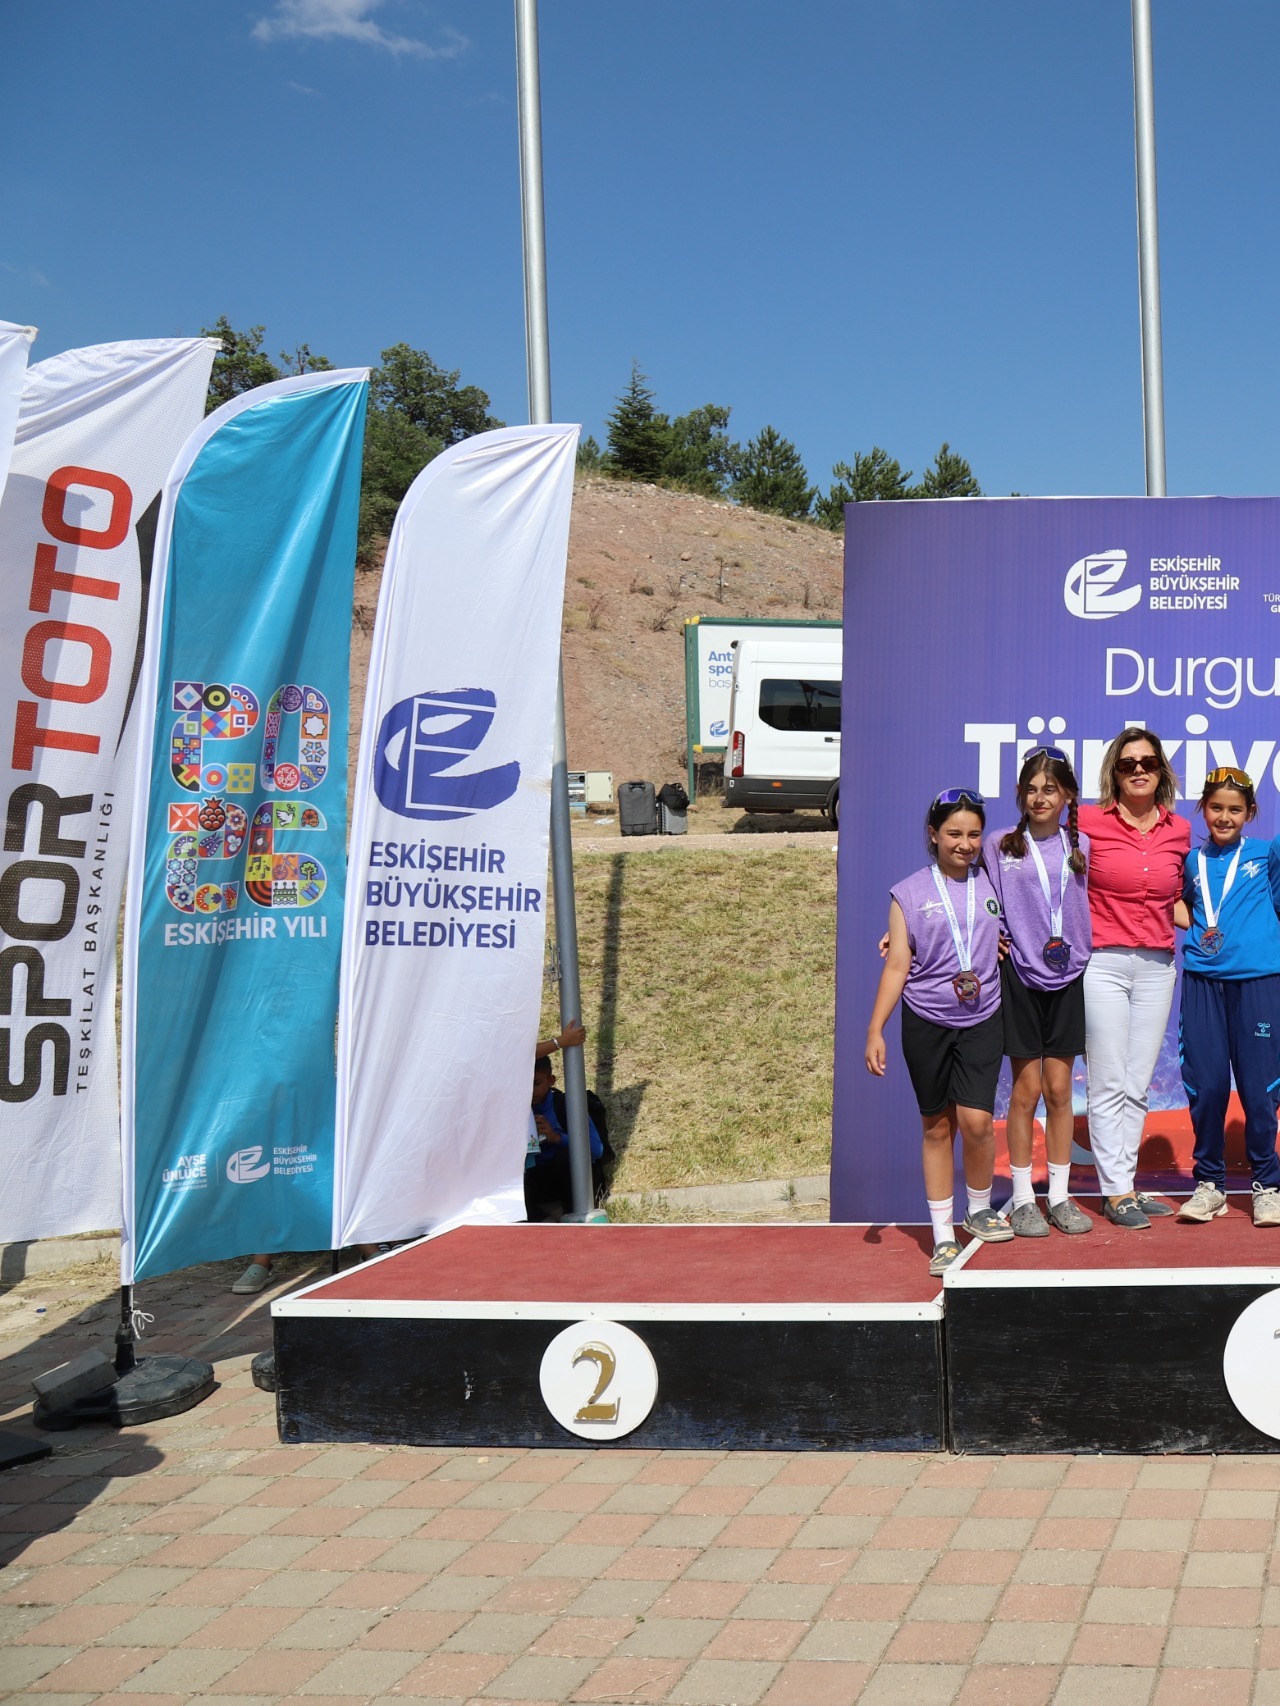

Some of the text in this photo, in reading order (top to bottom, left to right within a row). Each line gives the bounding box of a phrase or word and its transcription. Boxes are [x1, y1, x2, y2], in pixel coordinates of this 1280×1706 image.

[1150, 555, 1221, 573] ESKİŞEHİR
[1149, 574, 1240, 592] BÜYÜKŞEHİR
[1149, 593, 1228, 610] BELEDİYESİ
[708, 651, 735, 662] Ant
[369, 838, 506, 874] ESKİŞEHİR
[366, 875, 541, 914] BÜYÜKŞEHİR
[76, 791, 114, 1094] TEŞKİLAT BAŞKANLIĞI
[164, 911, 327, 947] ESKİŞEHİR YILI
[365, 916, 516, 949] BELEDİYESİ
[571, 1340, 622, 1426] 2
